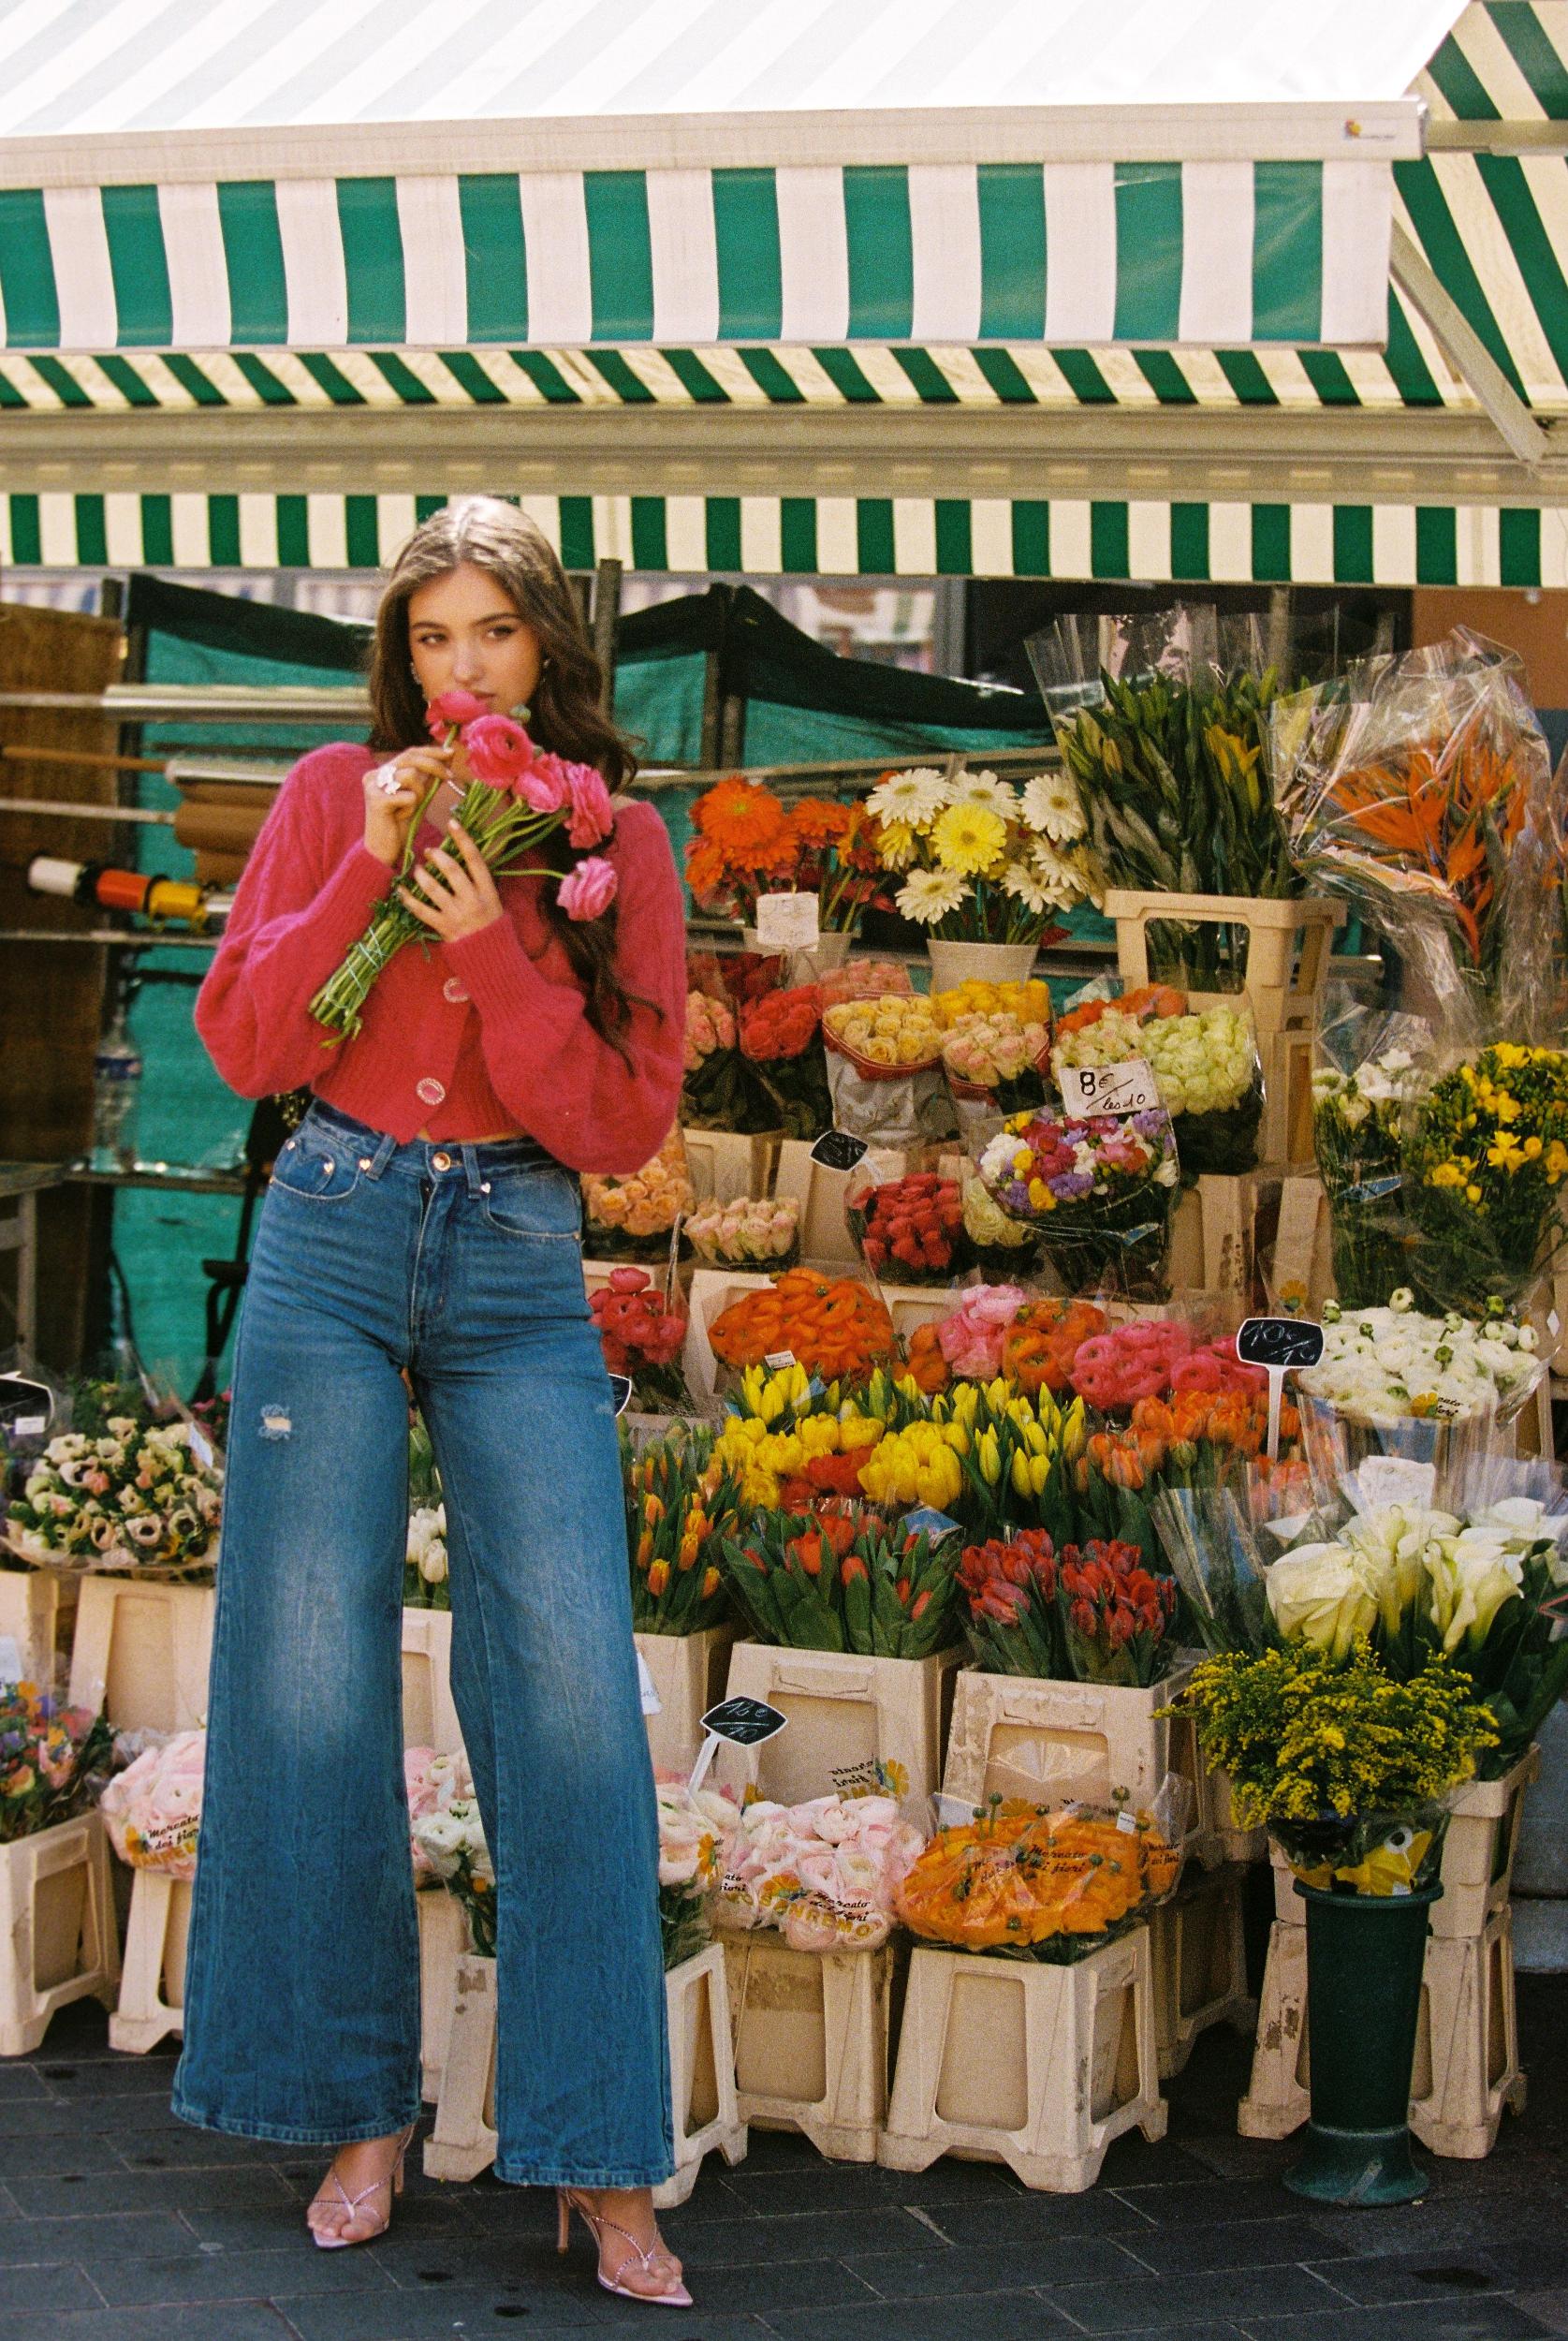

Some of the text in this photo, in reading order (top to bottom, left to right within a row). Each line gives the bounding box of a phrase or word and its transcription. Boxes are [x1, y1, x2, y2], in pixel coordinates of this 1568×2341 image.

[1102, 1097, 1121, 1111] les
[147, 1813, 200, 1838] Mercato
[154, 1835, 173, 1850] dei
